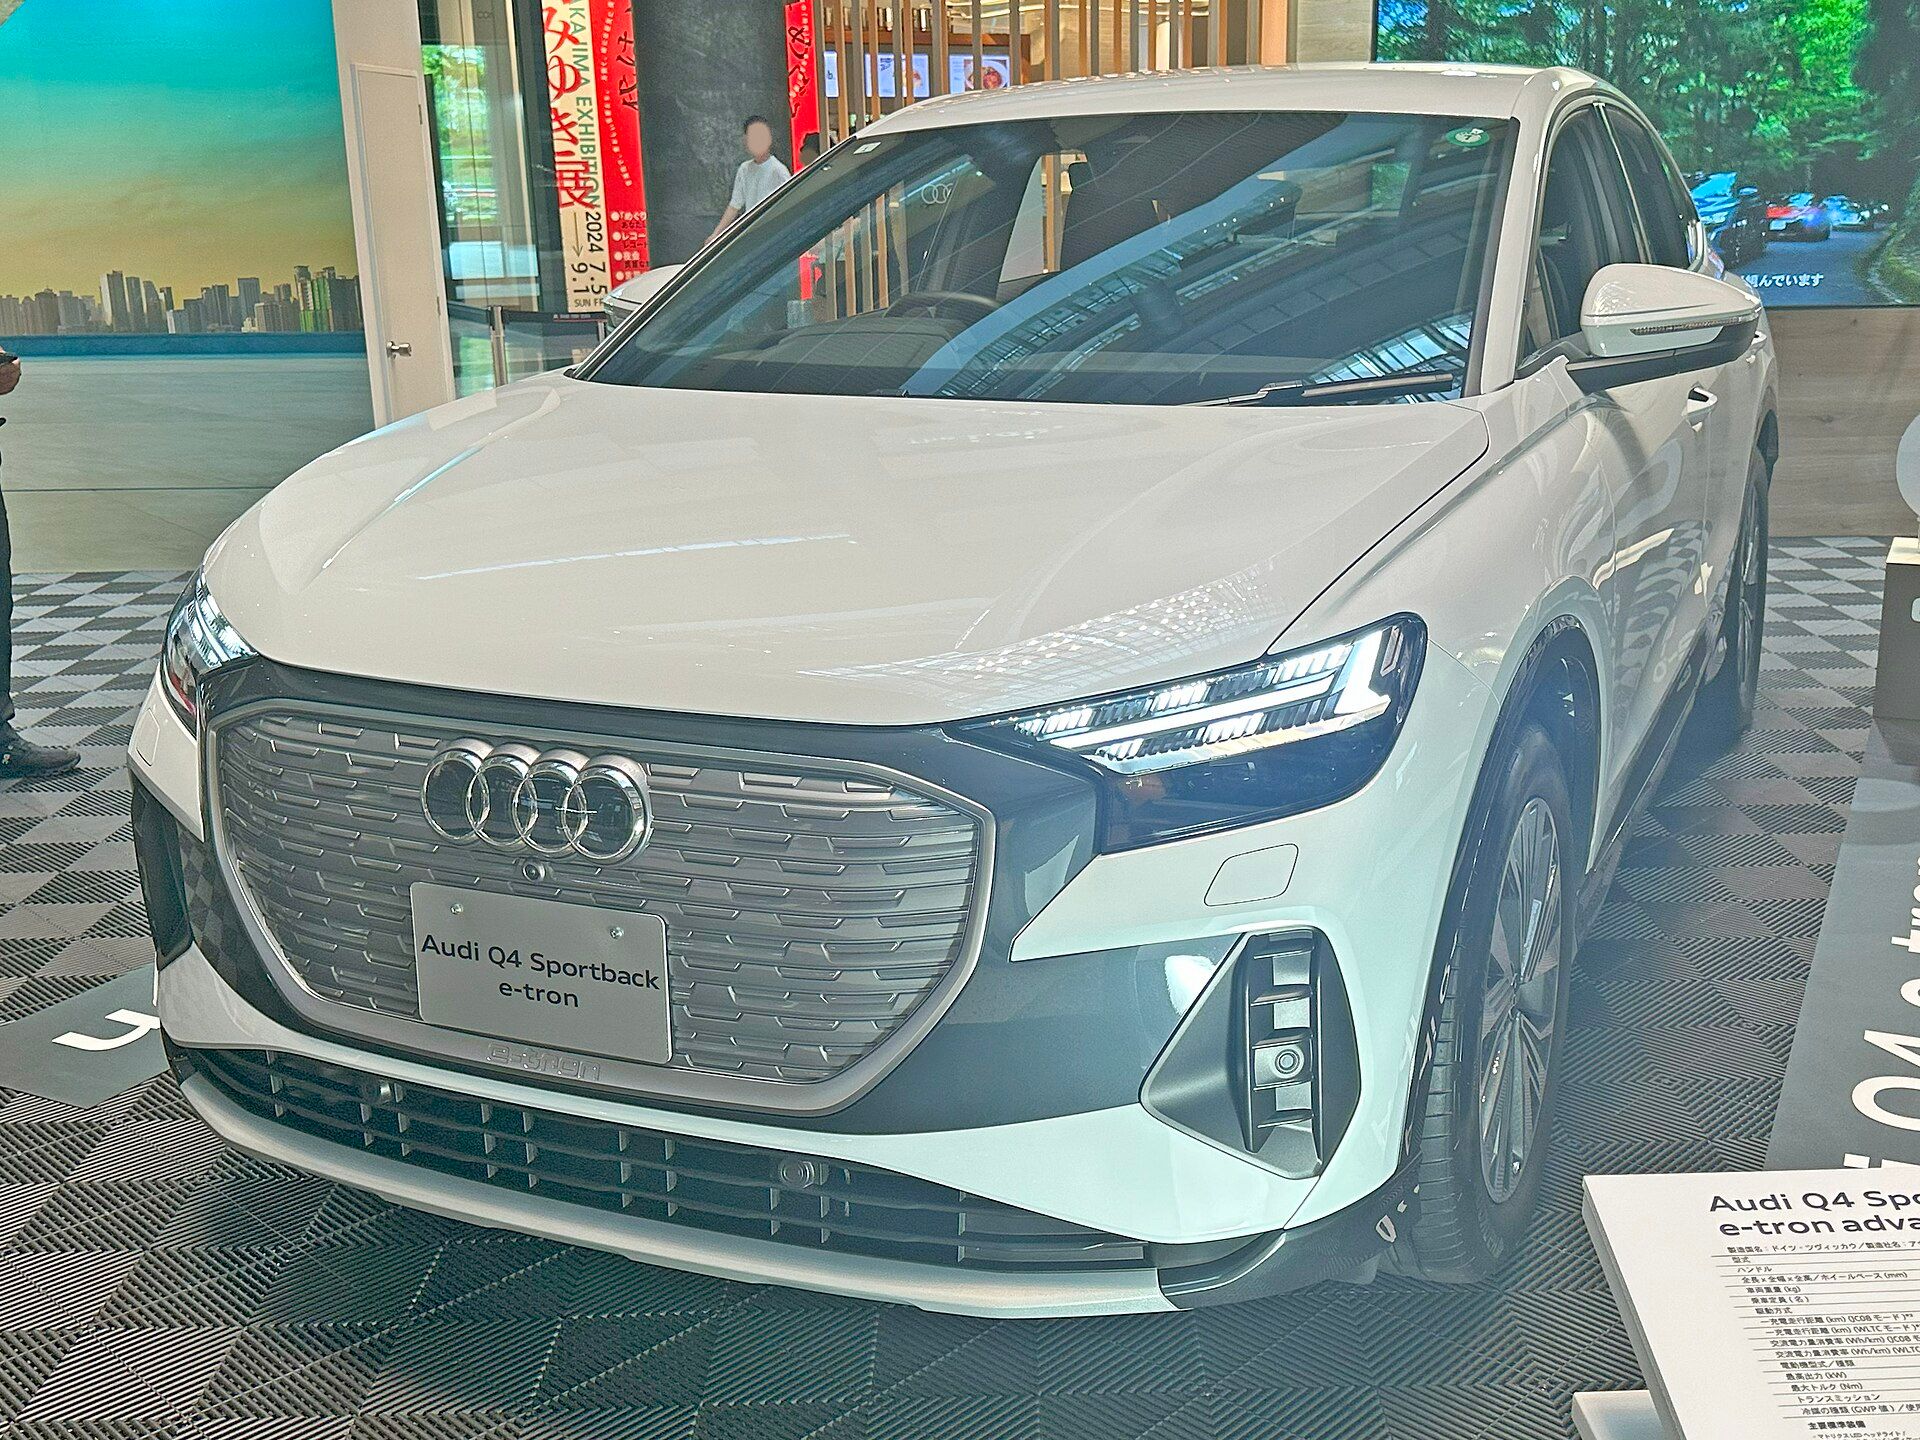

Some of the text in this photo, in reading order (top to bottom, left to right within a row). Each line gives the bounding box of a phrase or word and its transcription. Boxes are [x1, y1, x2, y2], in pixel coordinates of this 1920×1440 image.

[569, 0, 591, 87] KAJIMA
[542, 0, 595, 209] みゆき展
[586, 211, 604, 253] 2024
[571, 262, 590, 295] 9.1
[589, 261, 608, 295] 7.5
[575, 299, 591, 307] SUN
[421, 934, 660, 990] Audi Q4 Sportback
[499, 981, 579, 1008] e-tron
[486, 1043, 600, 1081] e-tron
[1710, 1194, 1793, 1212] Audi
[1802, 1191, 1855, 1211] Q4
[1719, 1215, 1920, 1236] e-tron adva
[1737, 1265, 1772, 1273] ハンドル
[1784, 1285, 1801, 1294] (kg)
[1755, 1307, 1793, 1315] 駆動方式
[1826, 1315, 1846, 1323] (km)
[1831, 1326, 1851, 1334] (km)
[1825, 1371, 1847, 1379] (kW)
[1791, 1382, 1863, 1392] 最大トルク (Nm)
[1797, 1393, 1880, 1403] トランスミッション
